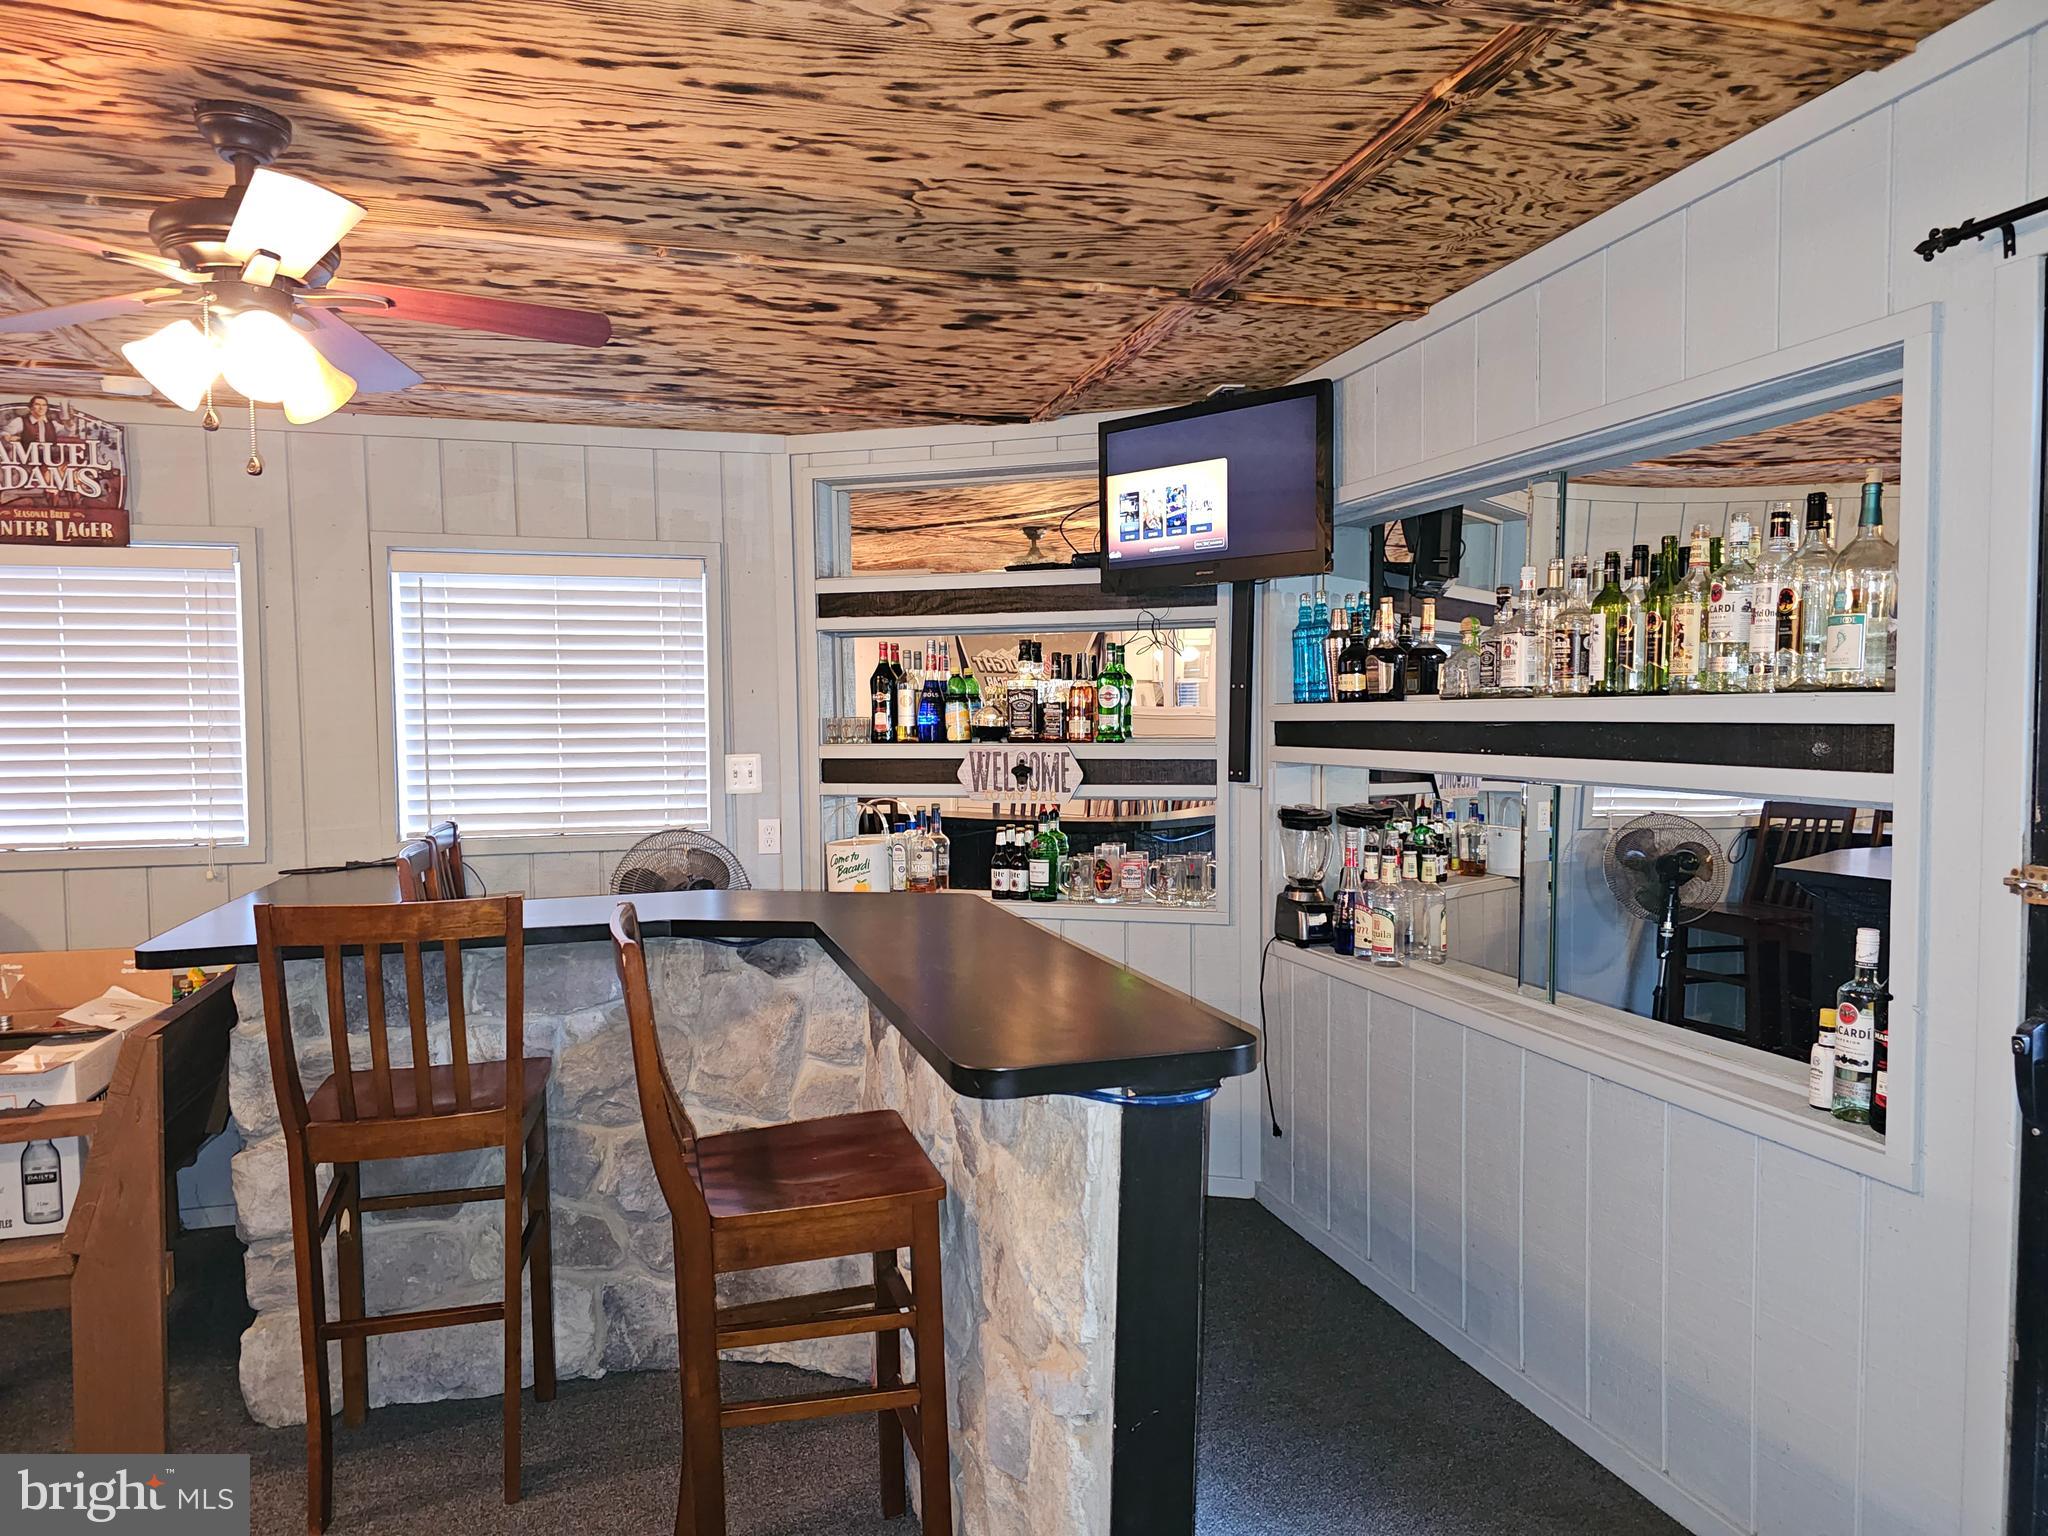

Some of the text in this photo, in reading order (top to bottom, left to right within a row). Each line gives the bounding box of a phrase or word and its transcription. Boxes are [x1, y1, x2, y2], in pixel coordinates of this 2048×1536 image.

[49, 509, 71, 519] BREW
[55, 520, 114, 542] LAGER
[830, 851, 860, 868] Come to
[836, 857, 871, 878] Bacardi
[1835, 1025, 1872, 1040] CARDÍ
